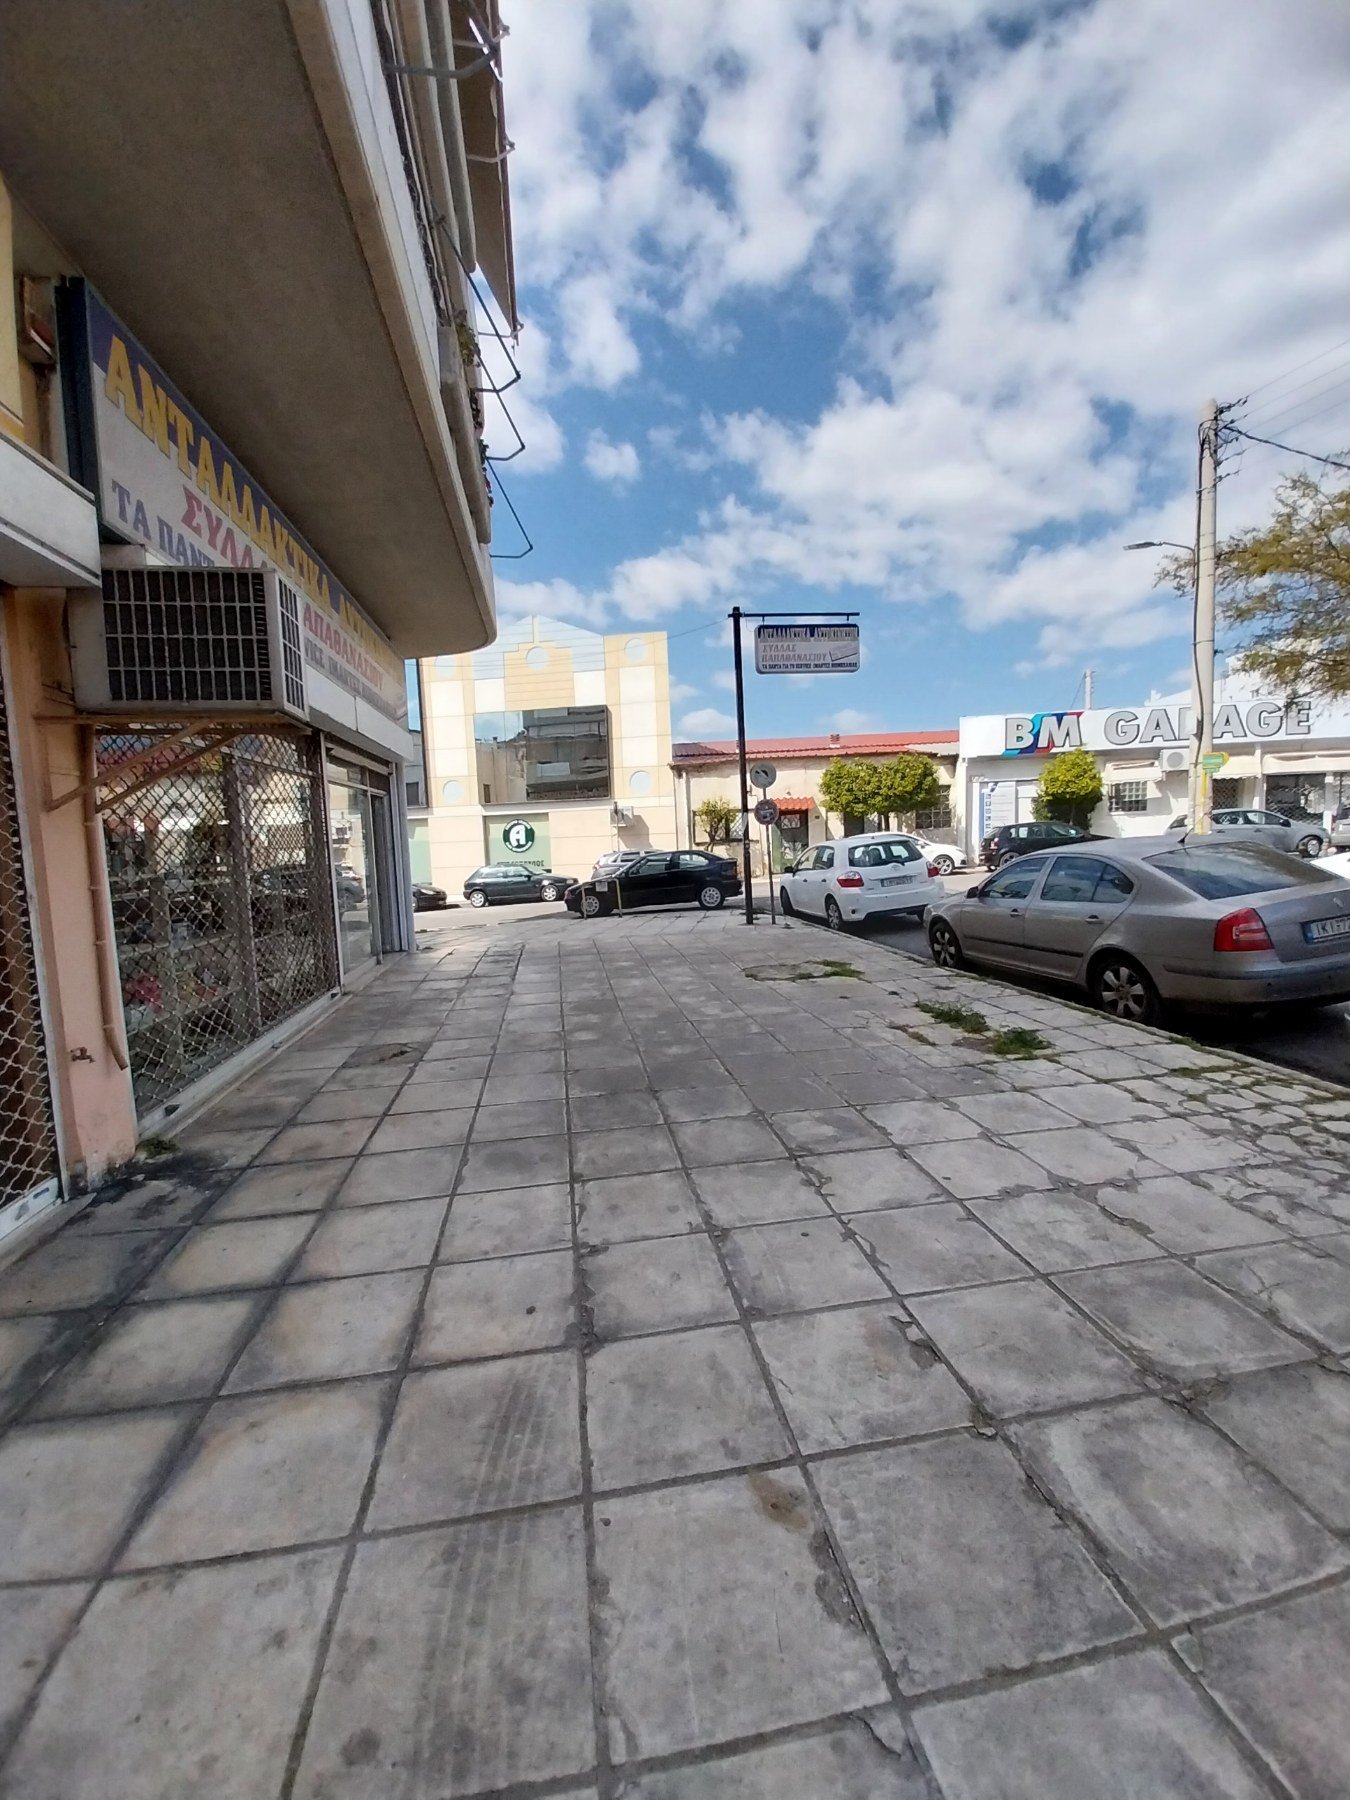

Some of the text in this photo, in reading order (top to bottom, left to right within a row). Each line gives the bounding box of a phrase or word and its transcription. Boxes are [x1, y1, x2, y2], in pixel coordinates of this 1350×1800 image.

[104, 334, 334, 621] ΑΝΤΑΛΛΑΚΤΙΚΑ
[111, 478, 152, 540] ΤΑ
[1005, 715, 1083, 750] BM
